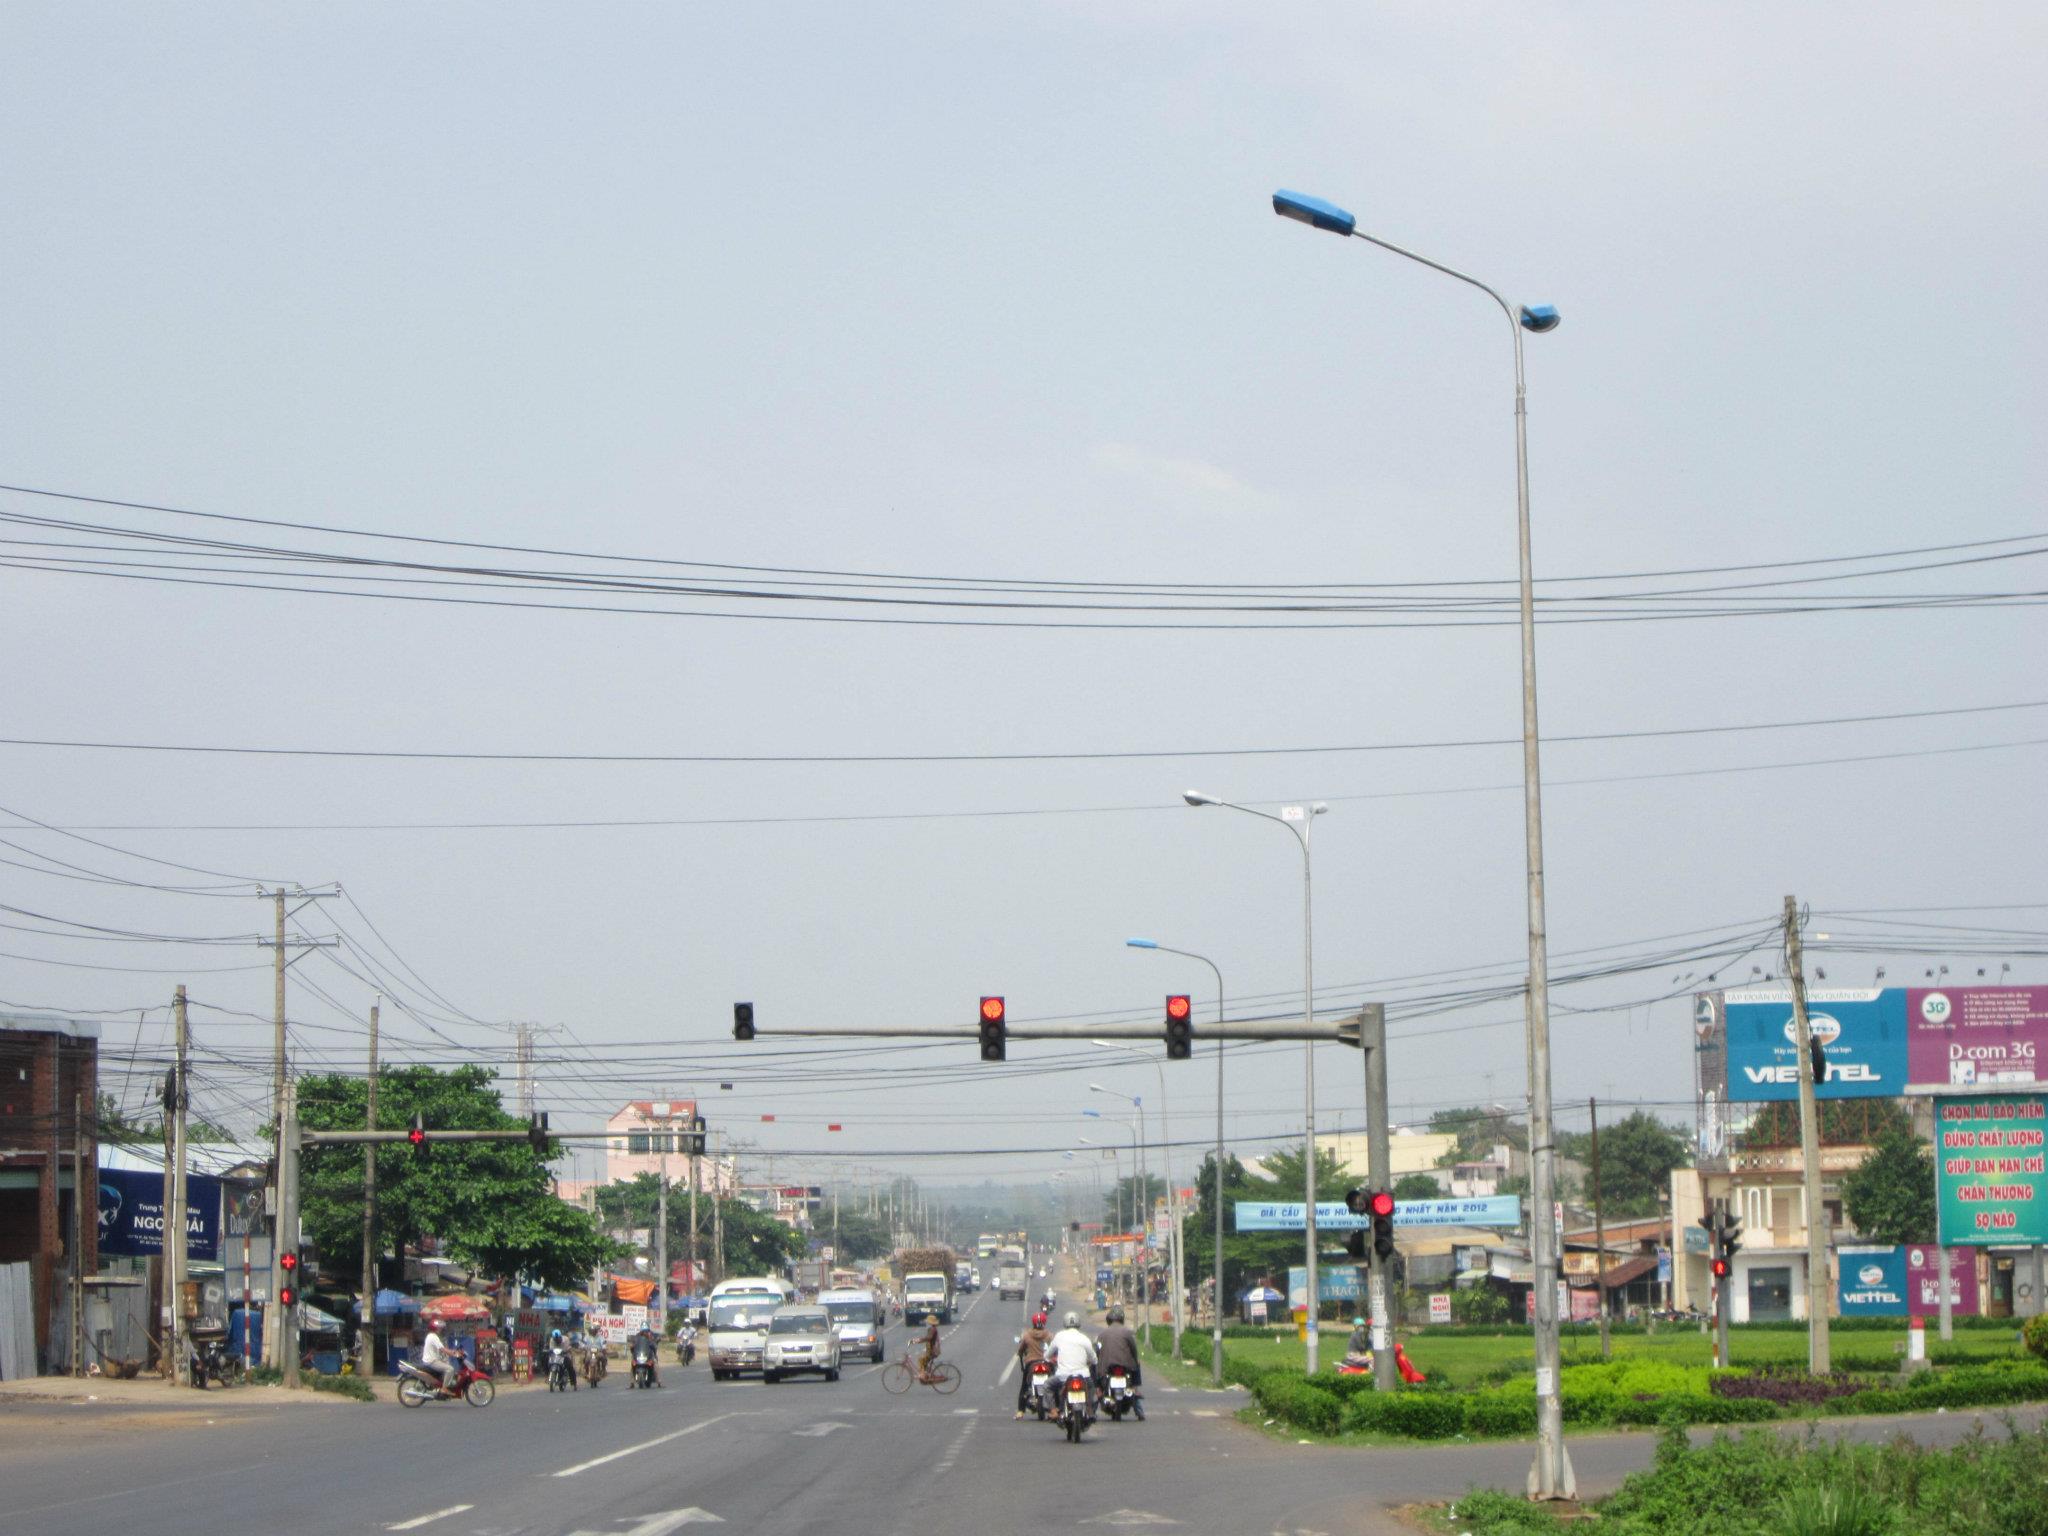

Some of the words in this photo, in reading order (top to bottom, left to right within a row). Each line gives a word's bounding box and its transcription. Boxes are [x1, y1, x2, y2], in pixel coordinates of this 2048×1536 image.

[1925, 1001, 1946, 1014] 3G
[2011, 1041, 2036, 1058] 3G
[138, 1204, 159, 1214] Trung
[1463, 1202, 1489, 1213] 2012
[134, 1216, 164, 1232] NGỌ
[1844, 1291, 1901, 1304] VIETTEL
